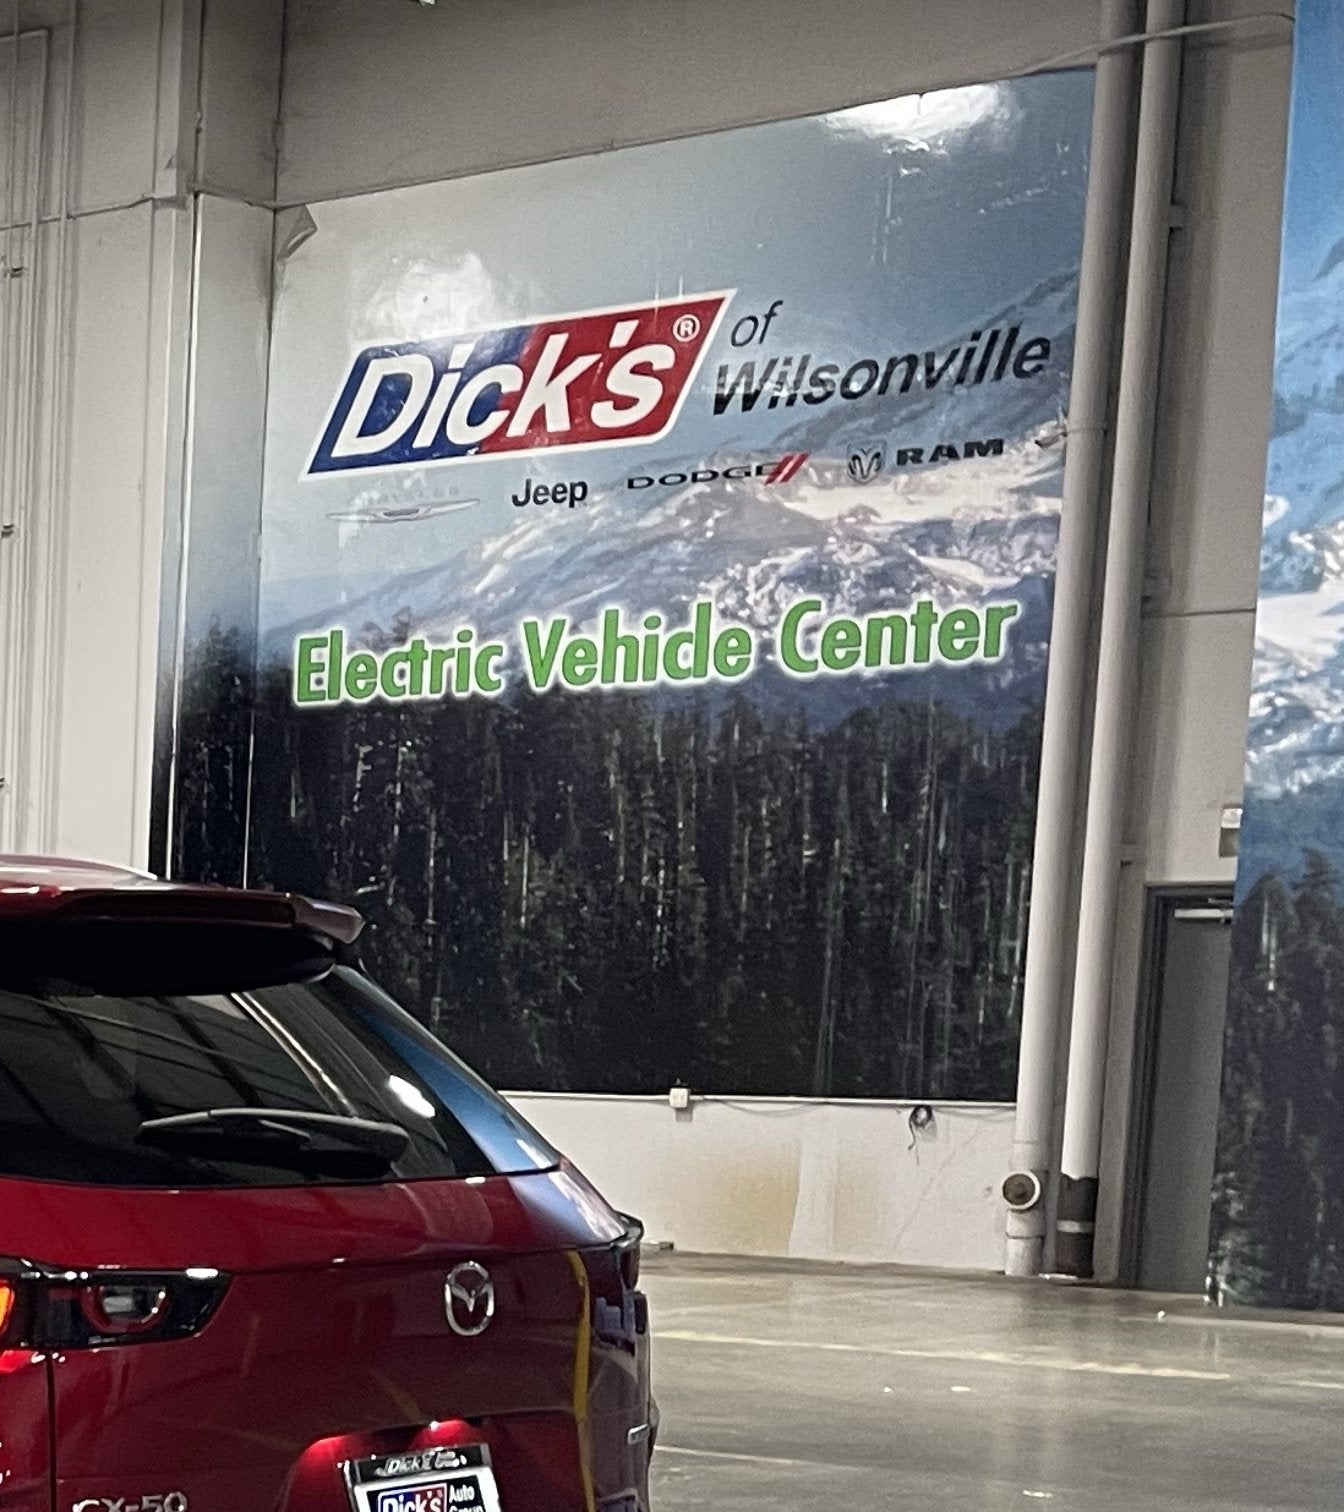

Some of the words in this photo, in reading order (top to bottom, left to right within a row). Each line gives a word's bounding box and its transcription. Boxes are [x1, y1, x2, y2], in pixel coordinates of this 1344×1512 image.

[330, 319, 677, 458] Dick's
[730, 300, 783, 347] of
[713, 327, 1052, 416] Wilsonville
[896, 438, 1005, 467] RAM
[511, 478, 588, 508] Jeep
[296, 628, 504, 702] Electric
[522, 600, 752, 688] Vehicle
[780, 599, 1018, 673] Center
[449, 1484, 476, 1503] Auto
